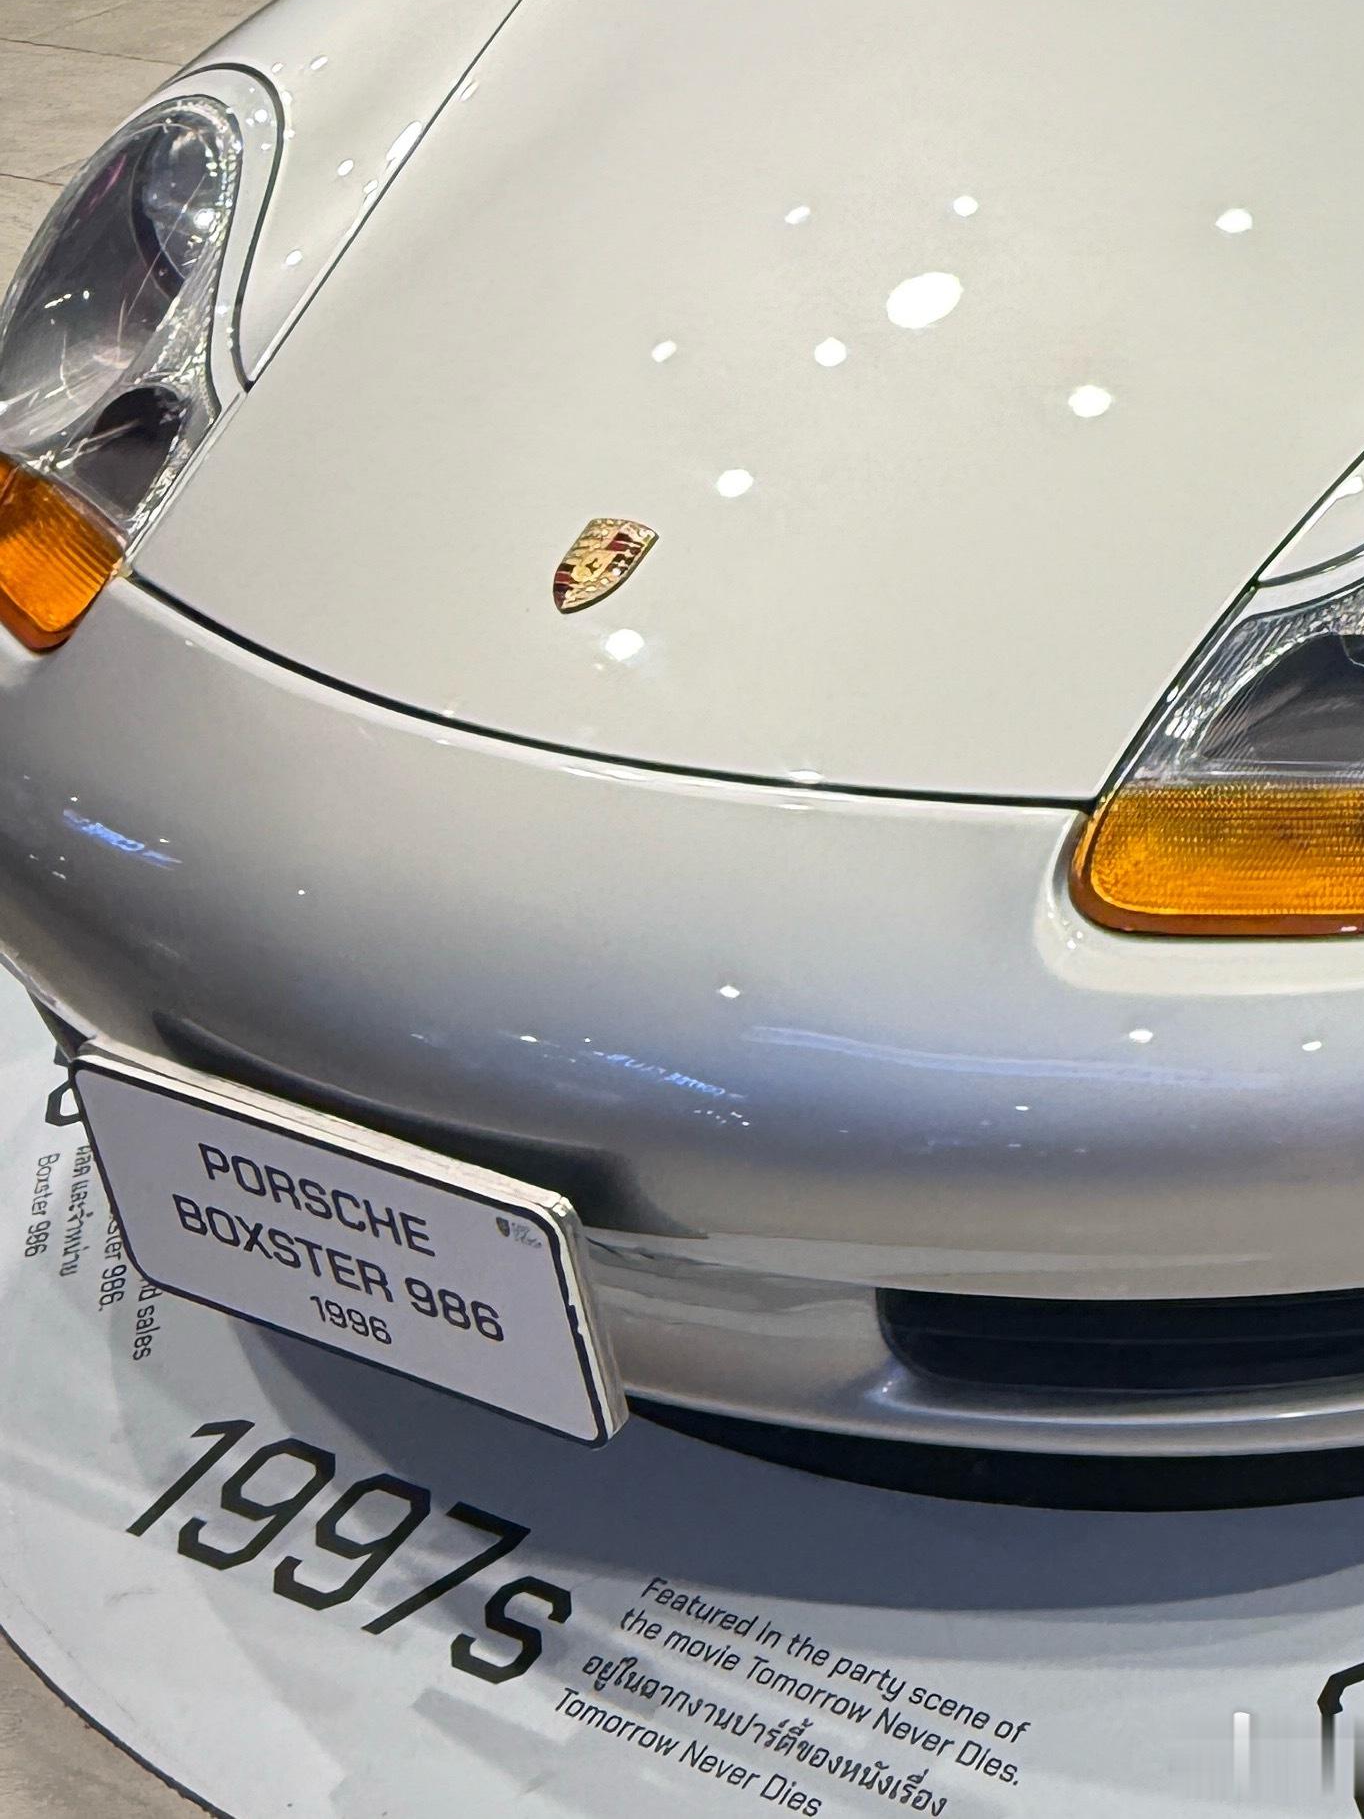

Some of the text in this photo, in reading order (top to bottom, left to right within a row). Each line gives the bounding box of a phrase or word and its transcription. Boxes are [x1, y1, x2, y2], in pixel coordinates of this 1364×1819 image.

[24, 1152, 60, 1258] Boxster 986
[198, 1142, 436, 1257] PORSCHE
[133, 1306, 161, 1361] sales
[172, 1194, 505, 1342] BOXSTER 986
[309, 1295, 393, 1345] 1996
[126, 1418, 573, 1685] 1997s
[620, 1608, 1019, 1787] the movie Tomorrow Never Dies.
[640, 1577, 760, 1637] Featured
[787, 1634, 830, 1667] the
[827, 1656, 907, 1703] party
[909, 1687, 991, 1730] scene
[994, 1720, 1032, 1744] of
[554, 1687, 823, 1818] Tomorrow Never Dies
